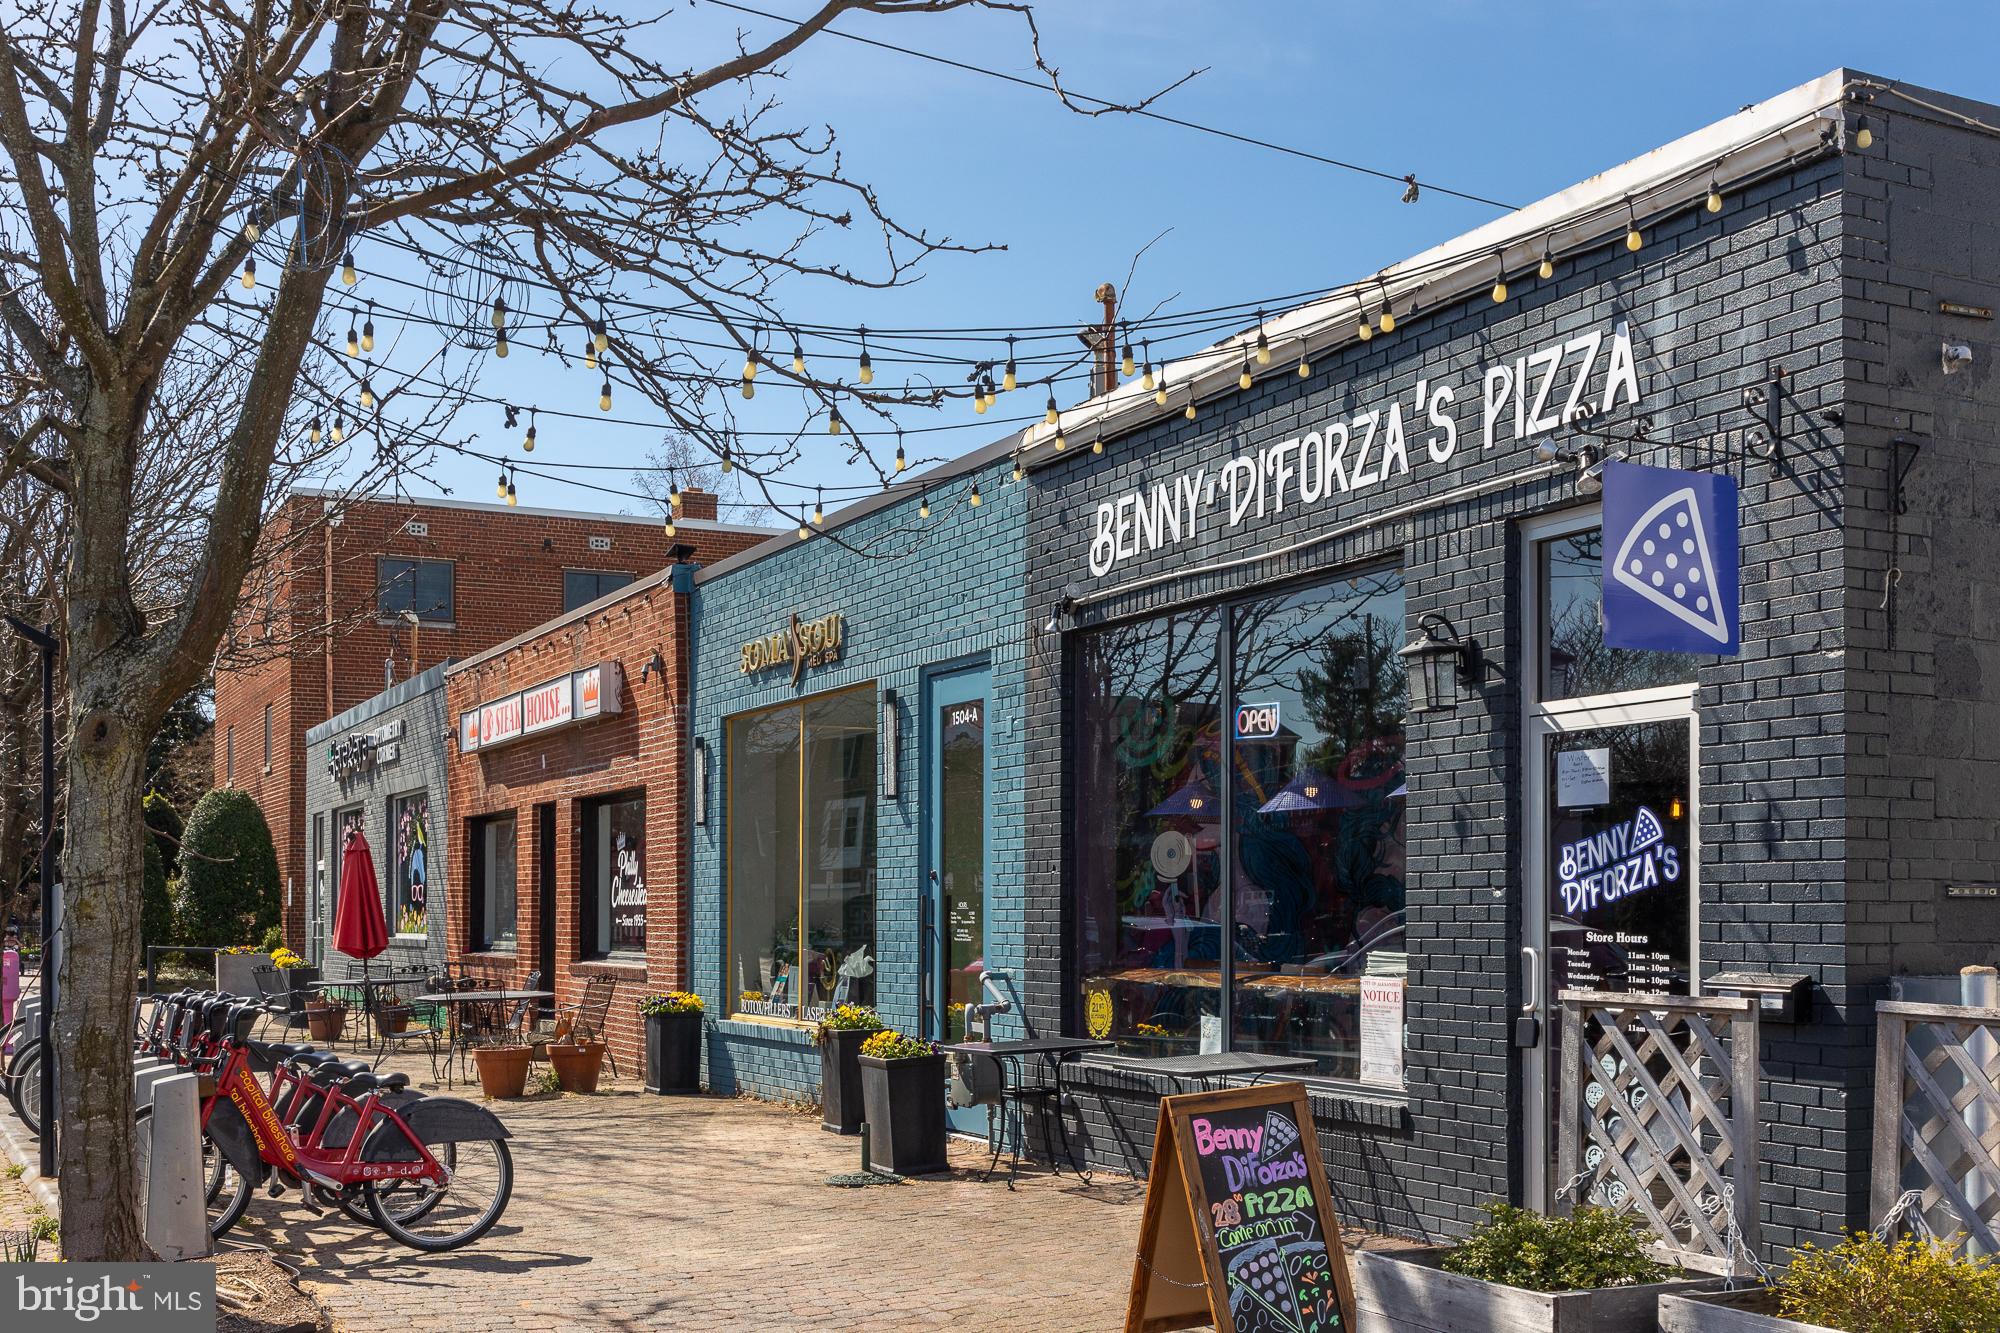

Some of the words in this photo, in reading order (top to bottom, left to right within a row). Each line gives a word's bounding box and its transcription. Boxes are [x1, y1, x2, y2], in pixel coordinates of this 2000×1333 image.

[1088, 468, 1206, 577] BENNY
[1220, 379, 1457, 527] DIFORZA'S
[1483, 321, 1640, 450] PIZZA
[740, 630, 790, 674] SOMA
[496, 700, 521, 736] STEAK
[952, 707, 978, 726] 1504-A
[1237, 708, 1276, 733] OPEN
[1559, 822, 1630, 881] BENNY
[618, 850, 638, 886] Philly
[1560, 843, 1679, 913] DIFORZA'S
[622, 914, 633, 926] Since
[633, 914, 644, 926] 1955
[1586, 931, 1613, 943] Store
[1616, 931, 1648, 944] Hours
[1567, 949, 1589, 957] Monday
[1651, 952, 1670, 961] 10pm
[1567, 960, 1591, 968] Tuesday
[1627, 963, 1645, 971] 11am
[1651, 964, 1670, 973] 10pm
[1567, 972, 1600, 982] Wednesday
[1627, 975, 1645, 983] 11am
[1651, 976, 1670, 985] 10pm
[1567, 984, 1594, 992] Thursday
[1362, 989, 1401, 1003] NOTICE
[741, 999, 791, 1018] BOTOX/FILLERS
[801, 1005, 825, 1021] LASER
[1628, 1024, 1646, 1032] 11am
[240, 1070, 268, 1109] capital
[262, 1107, 295, 1161] bikeshare
[1192, 1118, 1264, 1156] Benny
[1222, 1150, 1308, 1193] DiForza's
[1219, 1225, 1254, 1248] Come
[1256, 1219, 1277, 1238] on
